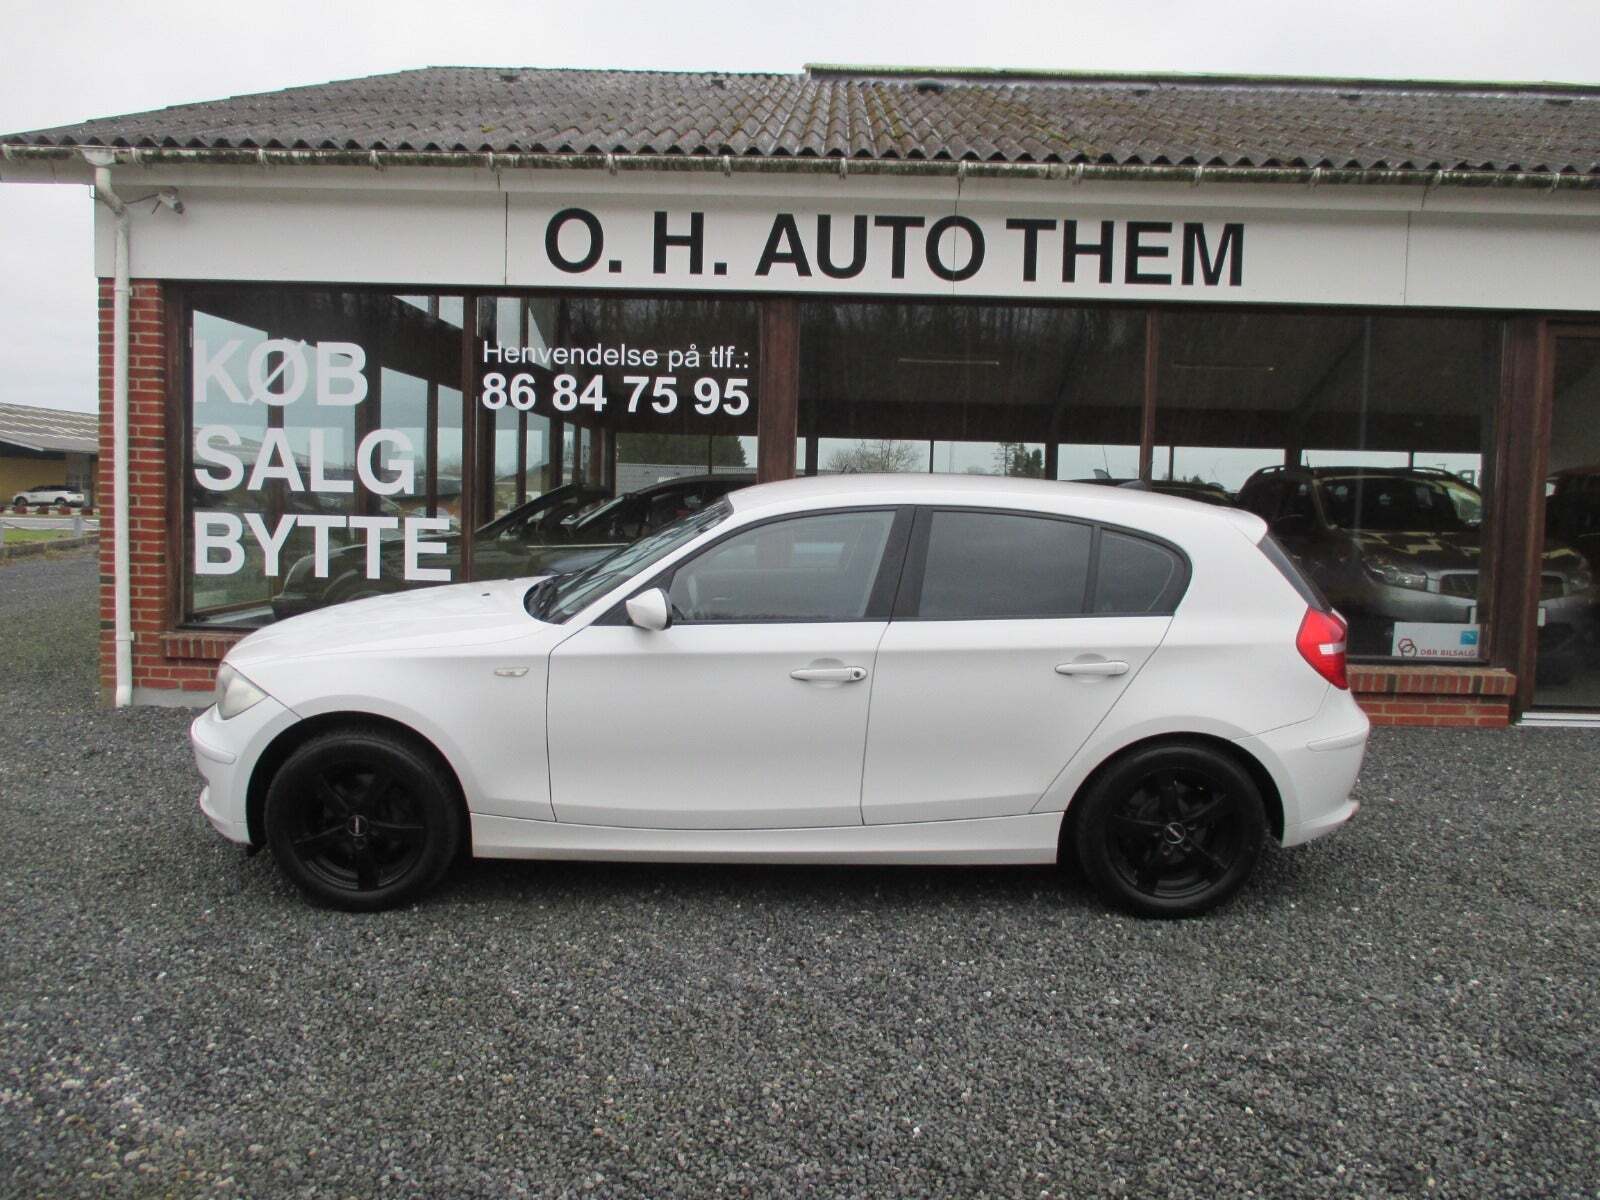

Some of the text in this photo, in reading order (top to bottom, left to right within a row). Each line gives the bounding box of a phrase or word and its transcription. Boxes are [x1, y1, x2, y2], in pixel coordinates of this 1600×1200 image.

[545, 207, 1245, 287] O. H. AUTO THEM
[193, 337, 368, 406] KØB
[483, 340, 749, 372] Henvendelse på tlf.:
[482, 372, 749, 415] 86 84 75 95
[194, 425, 415, 495] SALG
[194, 512, 451, 581] BYTTE
